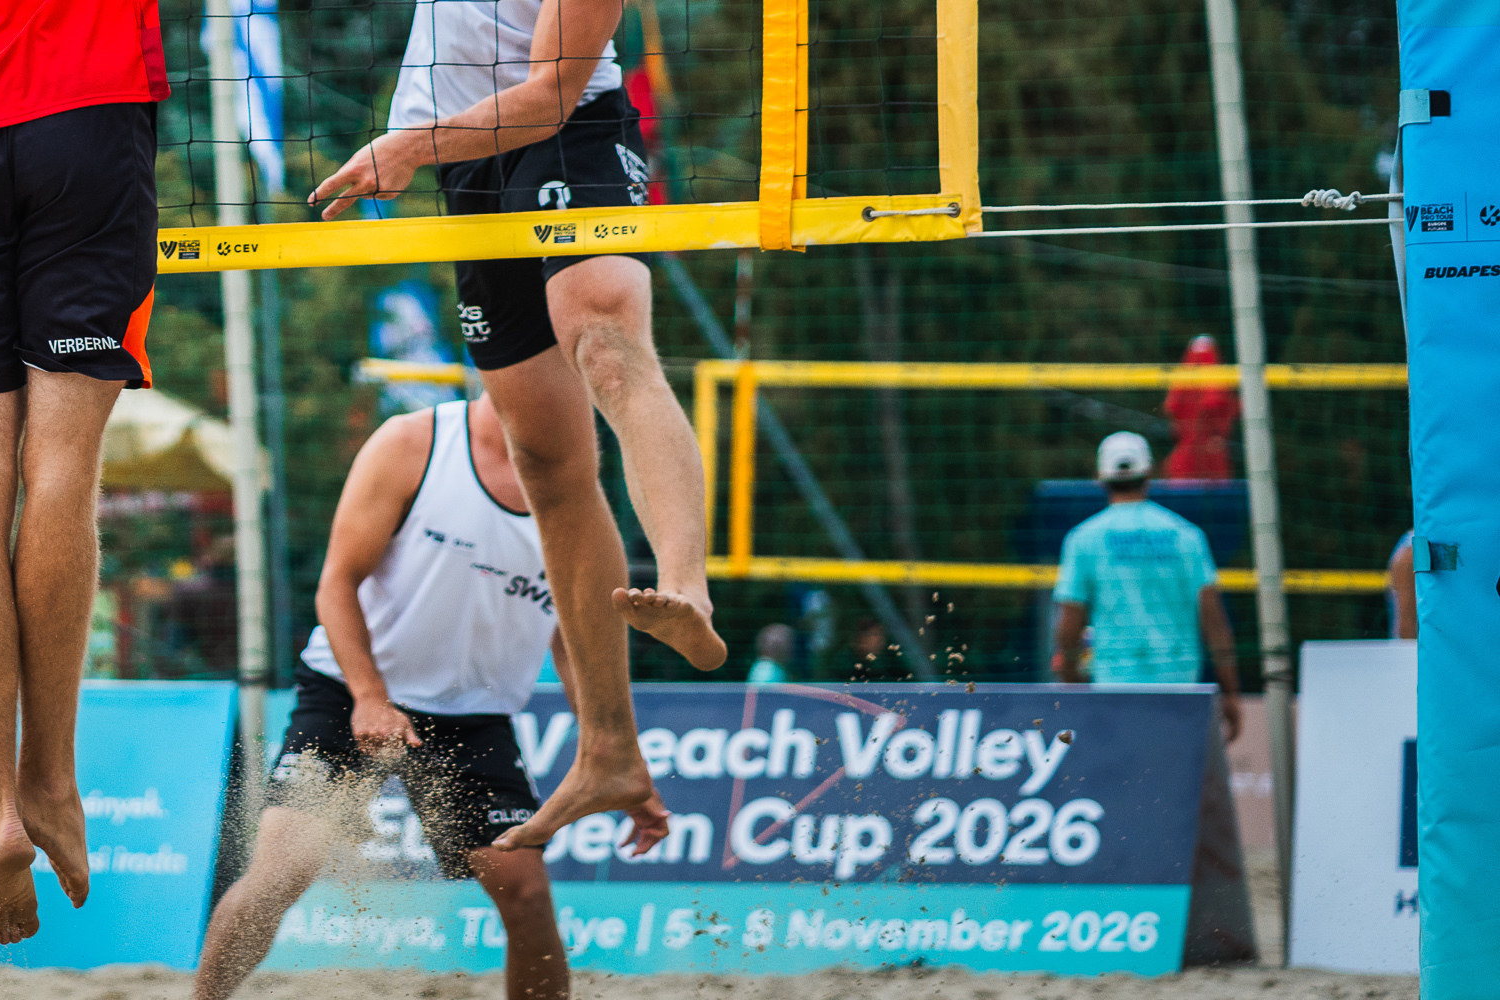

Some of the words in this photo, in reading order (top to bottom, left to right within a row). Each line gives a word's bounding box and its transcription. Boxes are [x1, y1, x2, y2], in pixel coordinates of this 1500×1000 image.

[1421, 206, 1453, 215] BEACH
[612, 225, 637, 235] CEV
[234, 243, 259, 253] CEV
[48, 336, 121, 354] VERBERNE
[504, 575, 554, 615] SWE
[638, 708, 817, 780] each
[835, 708, 1077, 796] Volley
[729, 796, 895, 880] Cup
[906, 797, 1106, 867] 2026
[662, 907, 696, 951] 5
[741, 908, 776, 951] 8
[786, 907, 1034, 954] November
[1037, 909, 1160, 954] 2026
